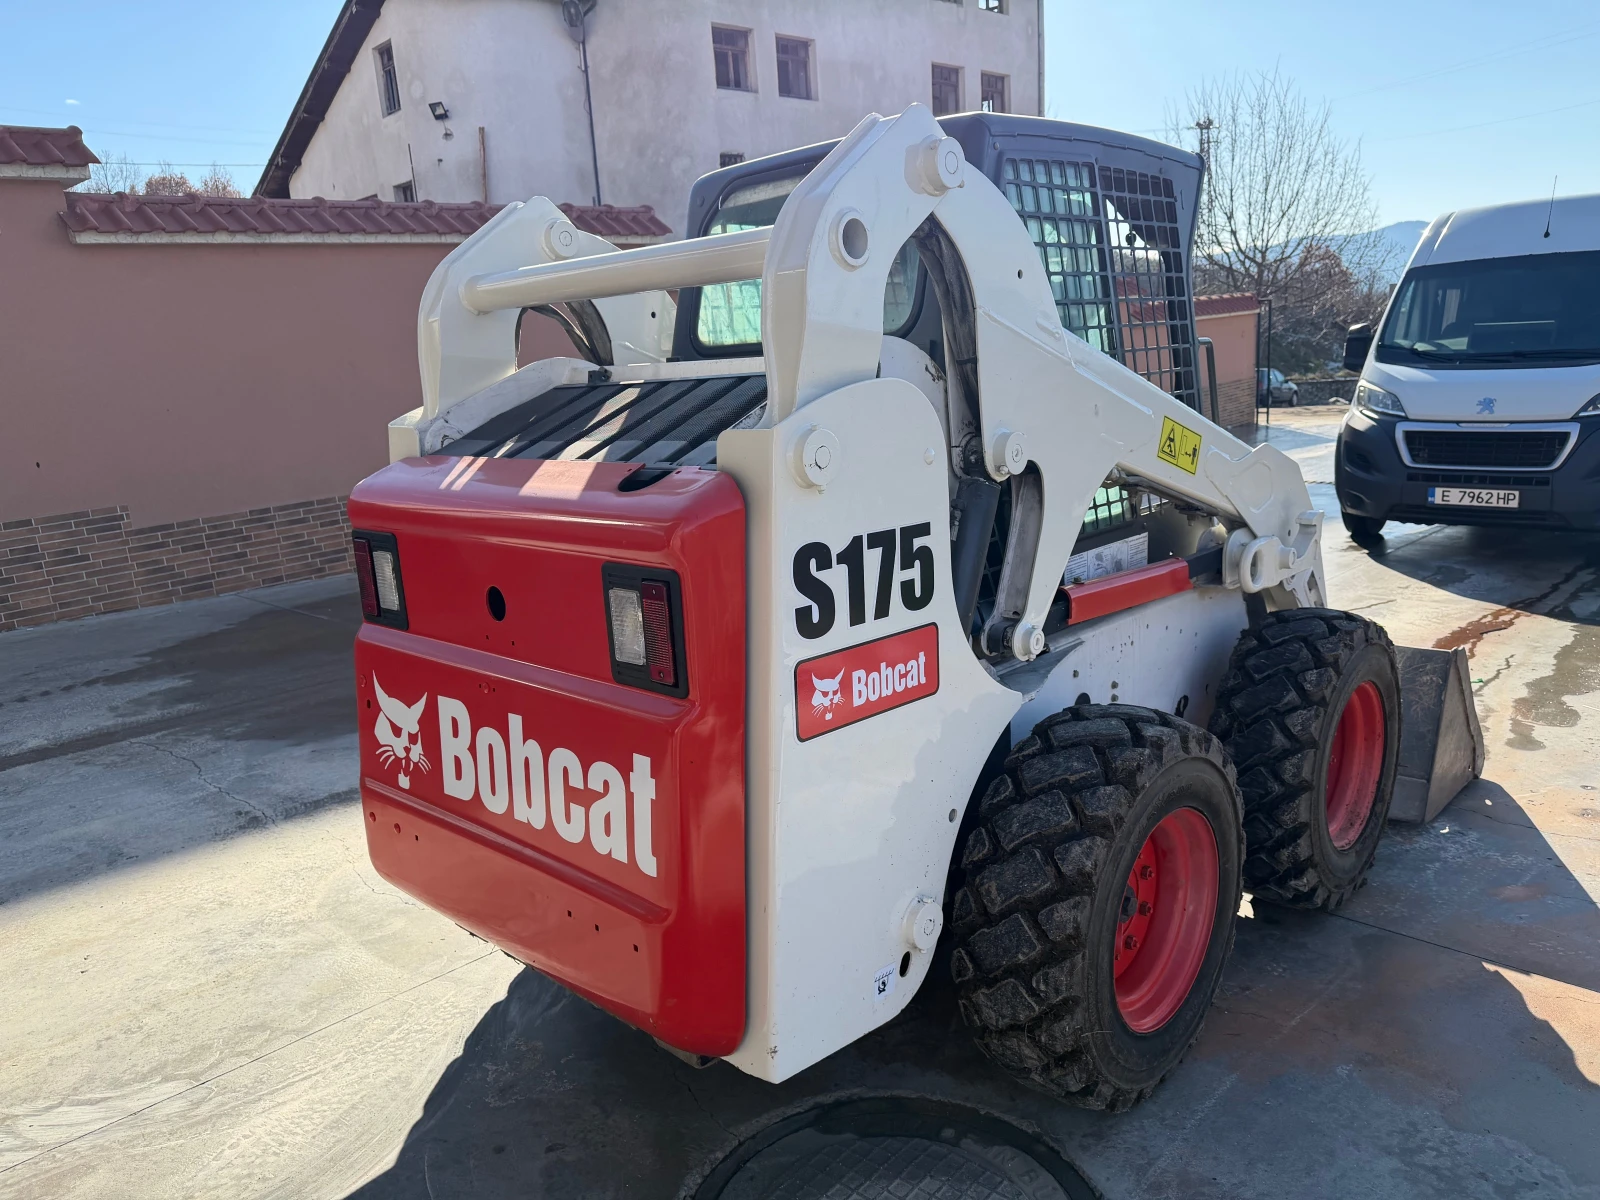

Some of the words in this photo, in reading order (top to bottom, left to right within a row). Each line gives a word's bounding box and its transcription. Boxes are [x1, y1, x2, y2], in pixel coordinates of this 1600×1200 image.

[1441, 490, 1451, 502] E
[1458, 490, 1494, 504] 7962
[1497, 492, 1516, 505] HP
[793, 521, 934, 640] S175
[852, 651, 926, 707] Bobcat
[437, 695, 658, 878] Bobcat
